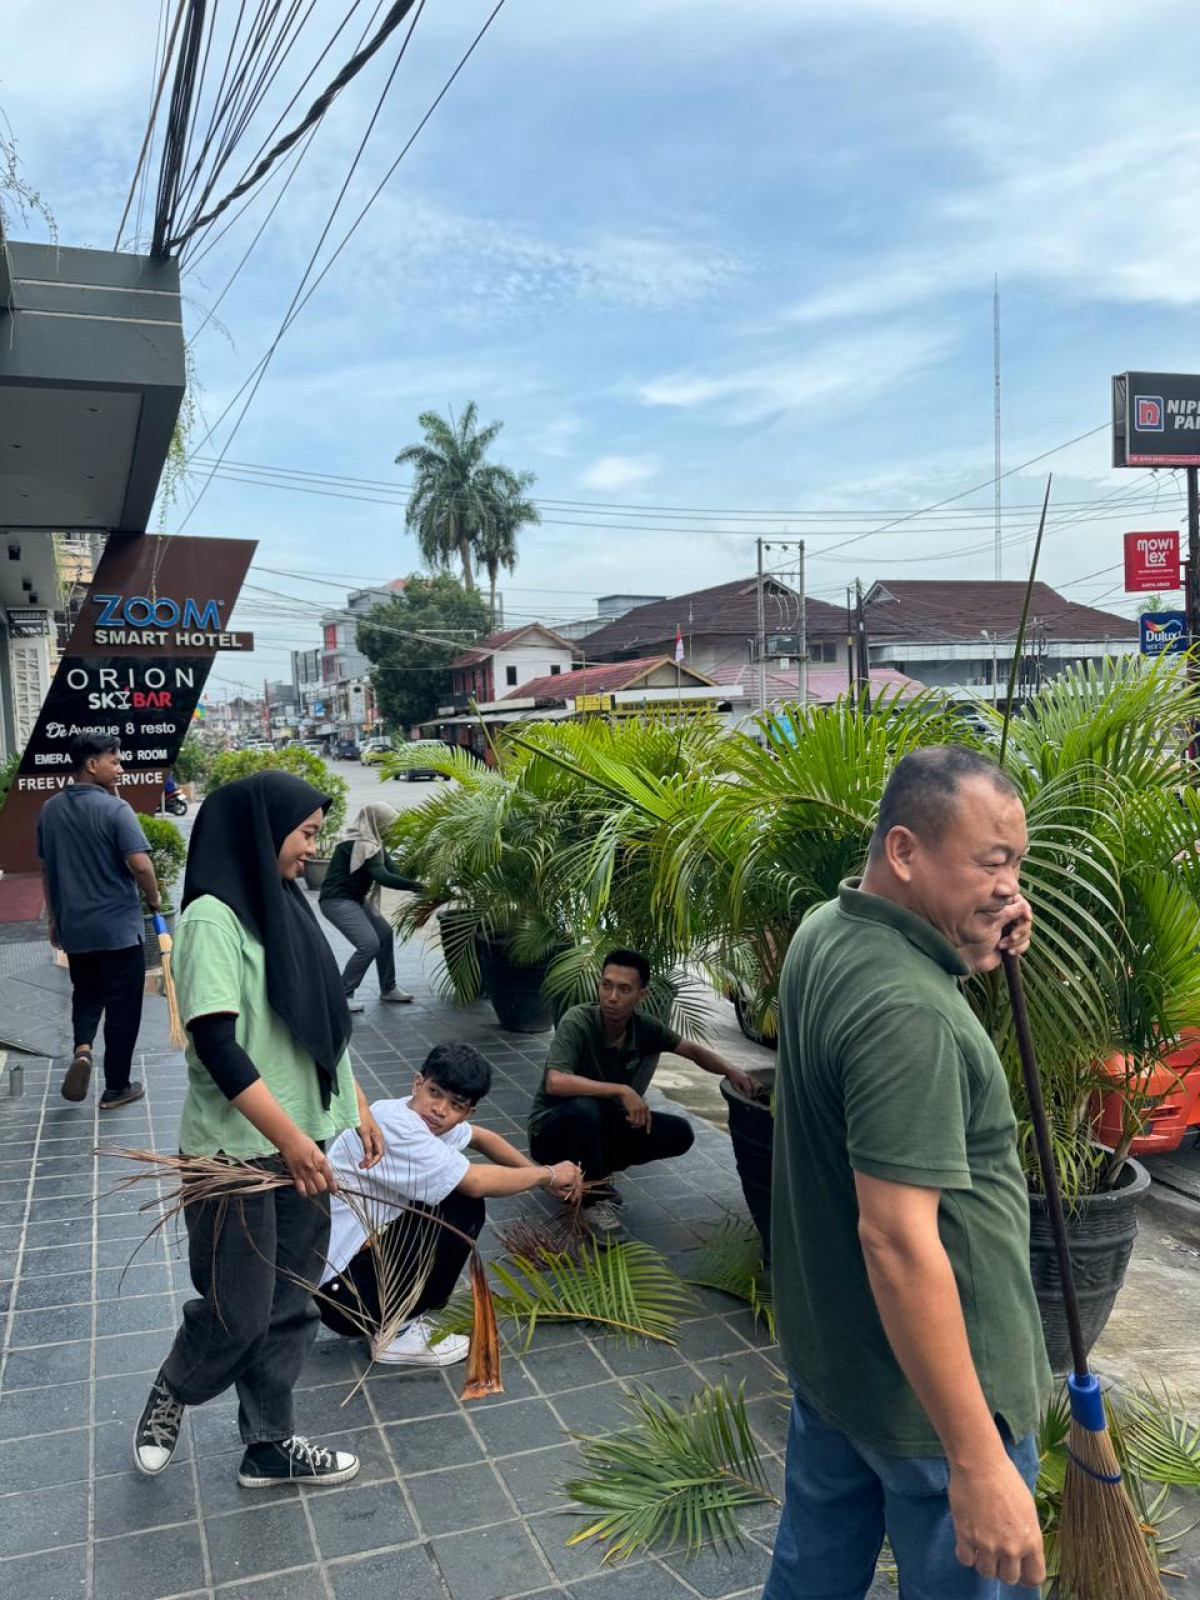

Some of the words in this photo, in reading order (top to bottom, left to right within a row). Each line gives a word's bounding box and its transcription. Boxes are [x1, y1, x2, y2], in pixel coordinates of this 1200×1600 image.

[92, 595, 221, 630] ZOOM
[94, 629, 169, 646] SMART
[175, 631, 243, 647] HOTEL
[67, 667, 194, 690] ORION
[125, 723, 135, 735] 8
[141, 722, 176, 735] resto
[34, 753, 73, 765] EMERA
[136, 749, 168, 761] ROOM
